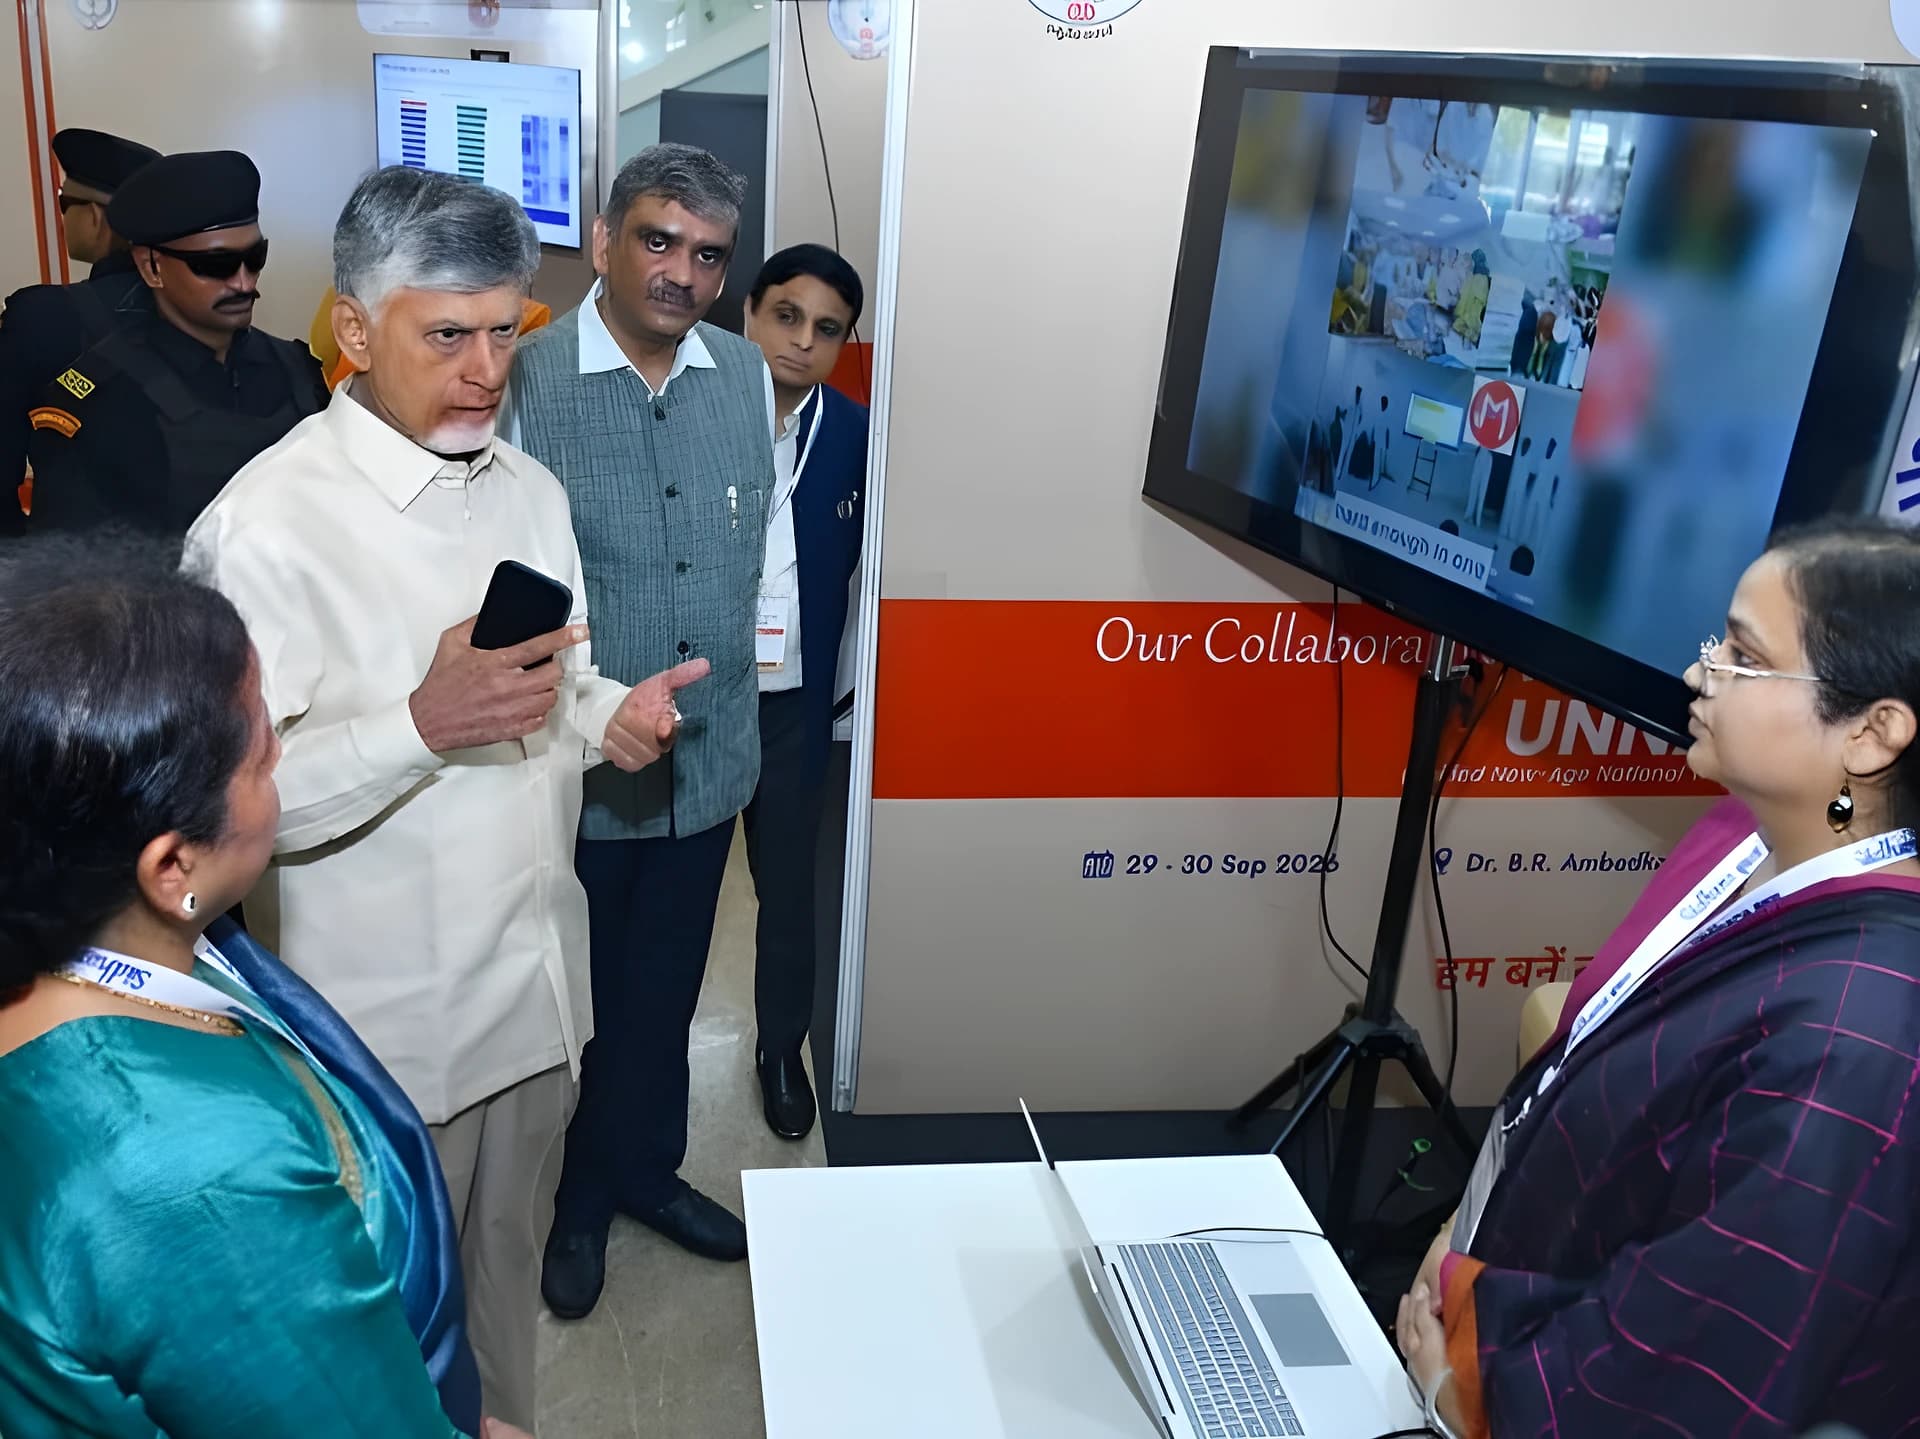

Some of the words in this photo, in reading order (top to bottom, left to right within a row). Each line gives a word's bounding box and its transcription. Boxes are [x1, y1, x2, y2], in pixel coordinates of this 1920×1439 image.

[1096, 616, 1193, 663] Our
[1126, 854, 1158, 875] 29
[1181, 854, 1213, 875] 30
[1466, 853, 1498, 873] Dr.
[1435, 957, 1496, 990] हम
